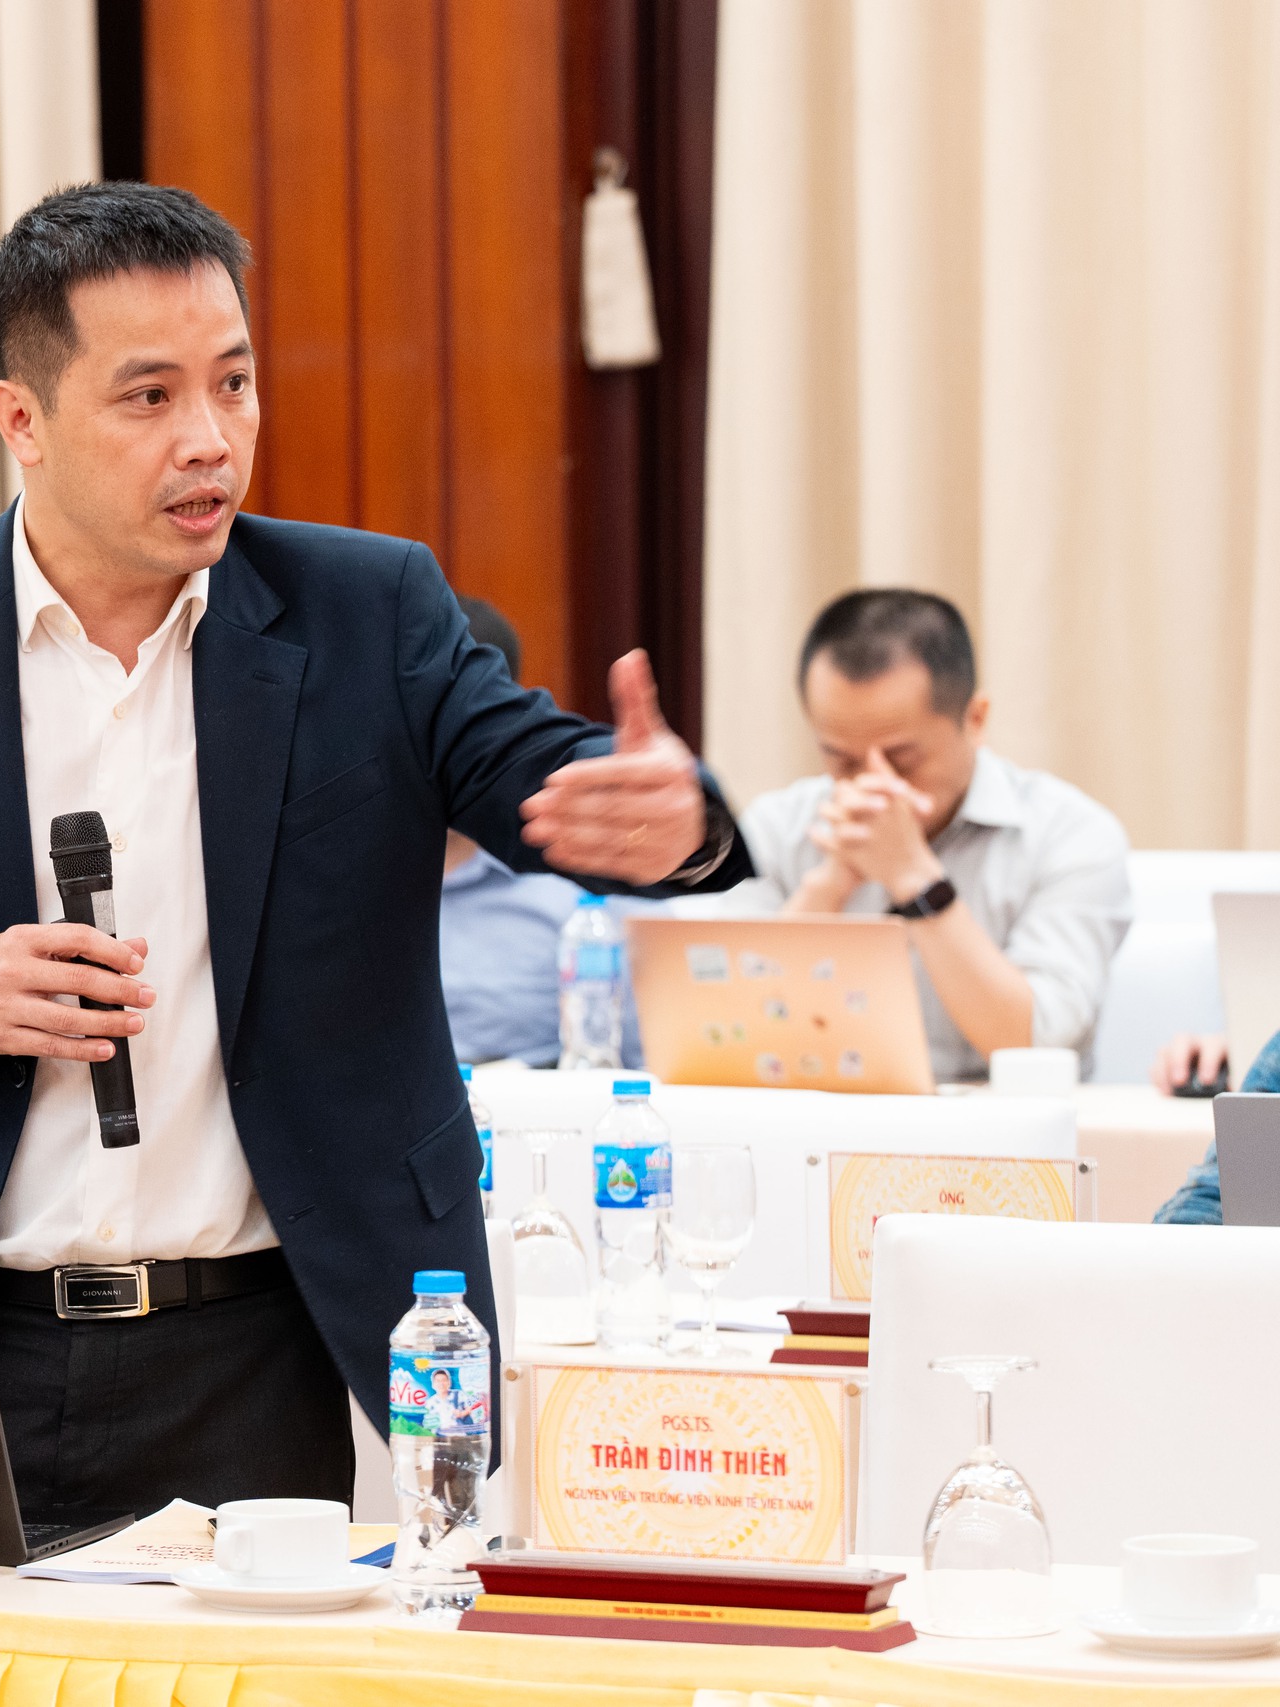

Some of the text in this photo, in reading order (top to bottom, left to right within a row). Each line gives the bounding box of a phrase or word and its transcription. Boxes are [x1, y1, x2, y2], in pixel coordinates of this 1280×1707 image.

[939, 1190, 964, 1205] ÔNG
[662, 1415, 714, 1432] PGS.TS.
[592, 1436, 786, 1476] TRẦN ĐÌNH THIÊN
[714, 1494, 742, 1508] KINH
[786, 1499, 814, 1512] NAM
